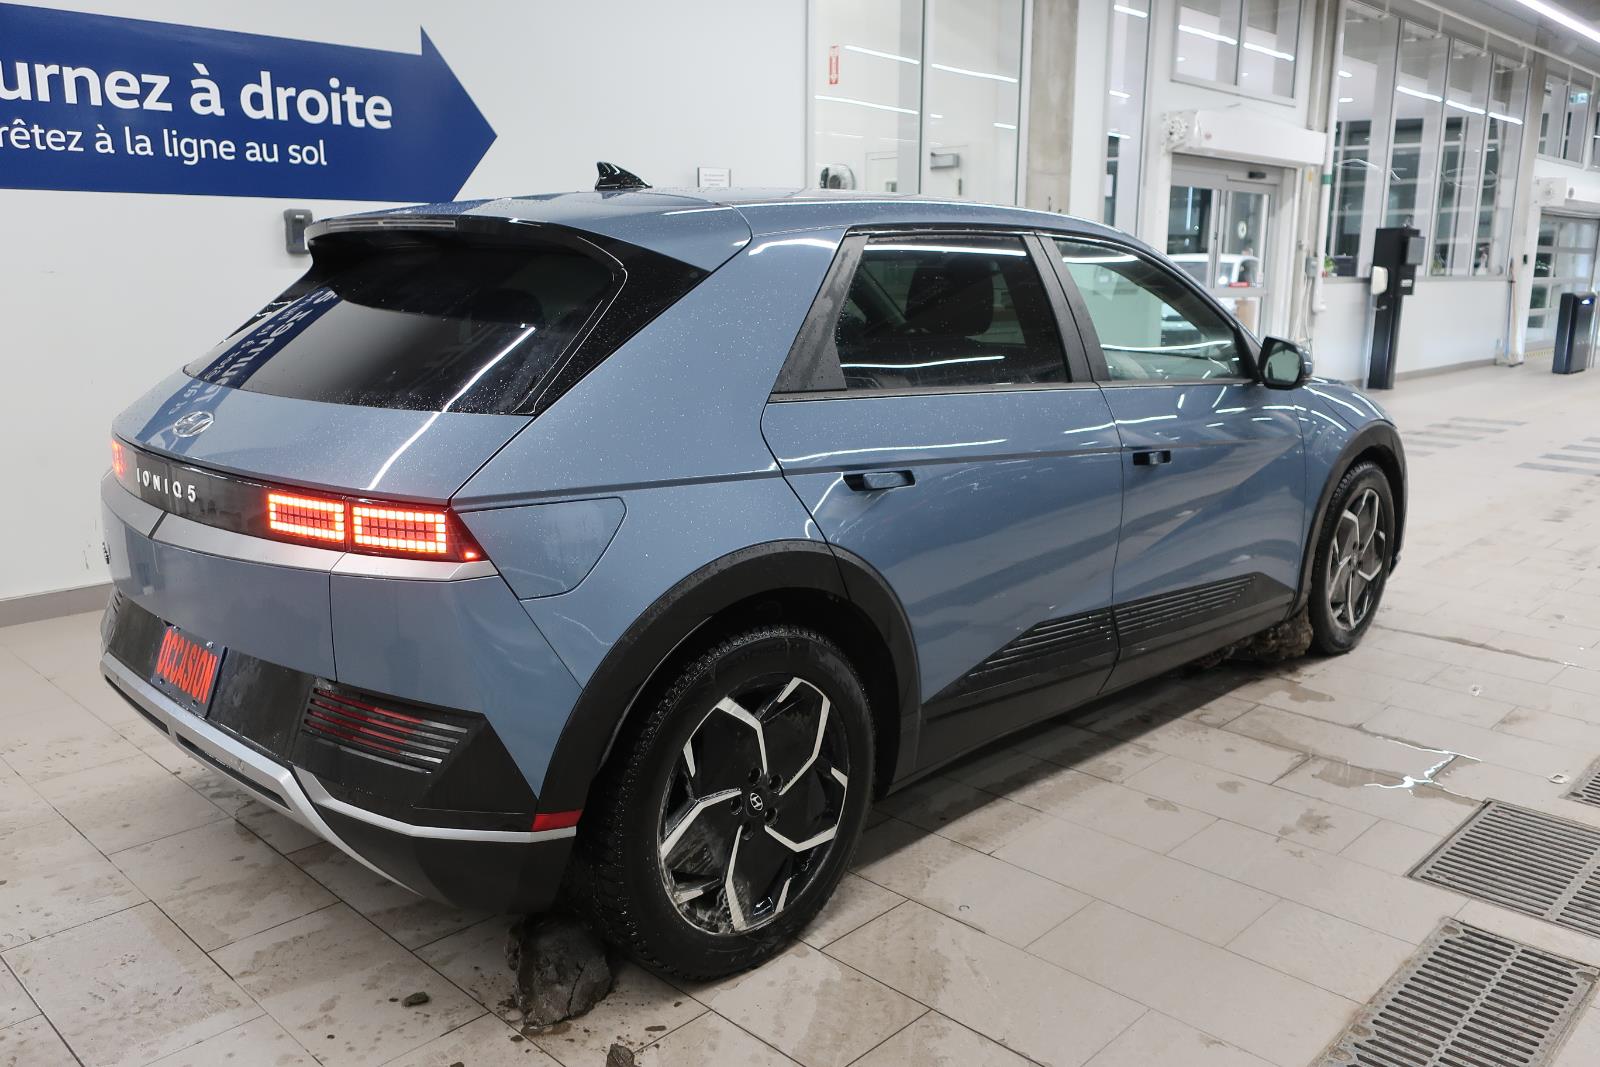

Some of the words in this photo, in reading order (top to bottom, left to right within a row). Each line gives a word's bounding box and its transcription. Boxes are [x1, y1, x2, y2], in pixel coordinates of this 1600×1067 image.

[190, 62, 226, 117] à
[240, 71, 393, 129] droite
[95, 124, 115, 154] à
[124, 126, 154, 156] la
[163, 128, 236, 166] ligne
[245, 141, 279, 163] au
[288, 139, 328, 166] sol
[136, 467, 182, 498] IONIQ
[187, 484, 196, 503] 5
[156, 628, 218, 704] OCCASION
